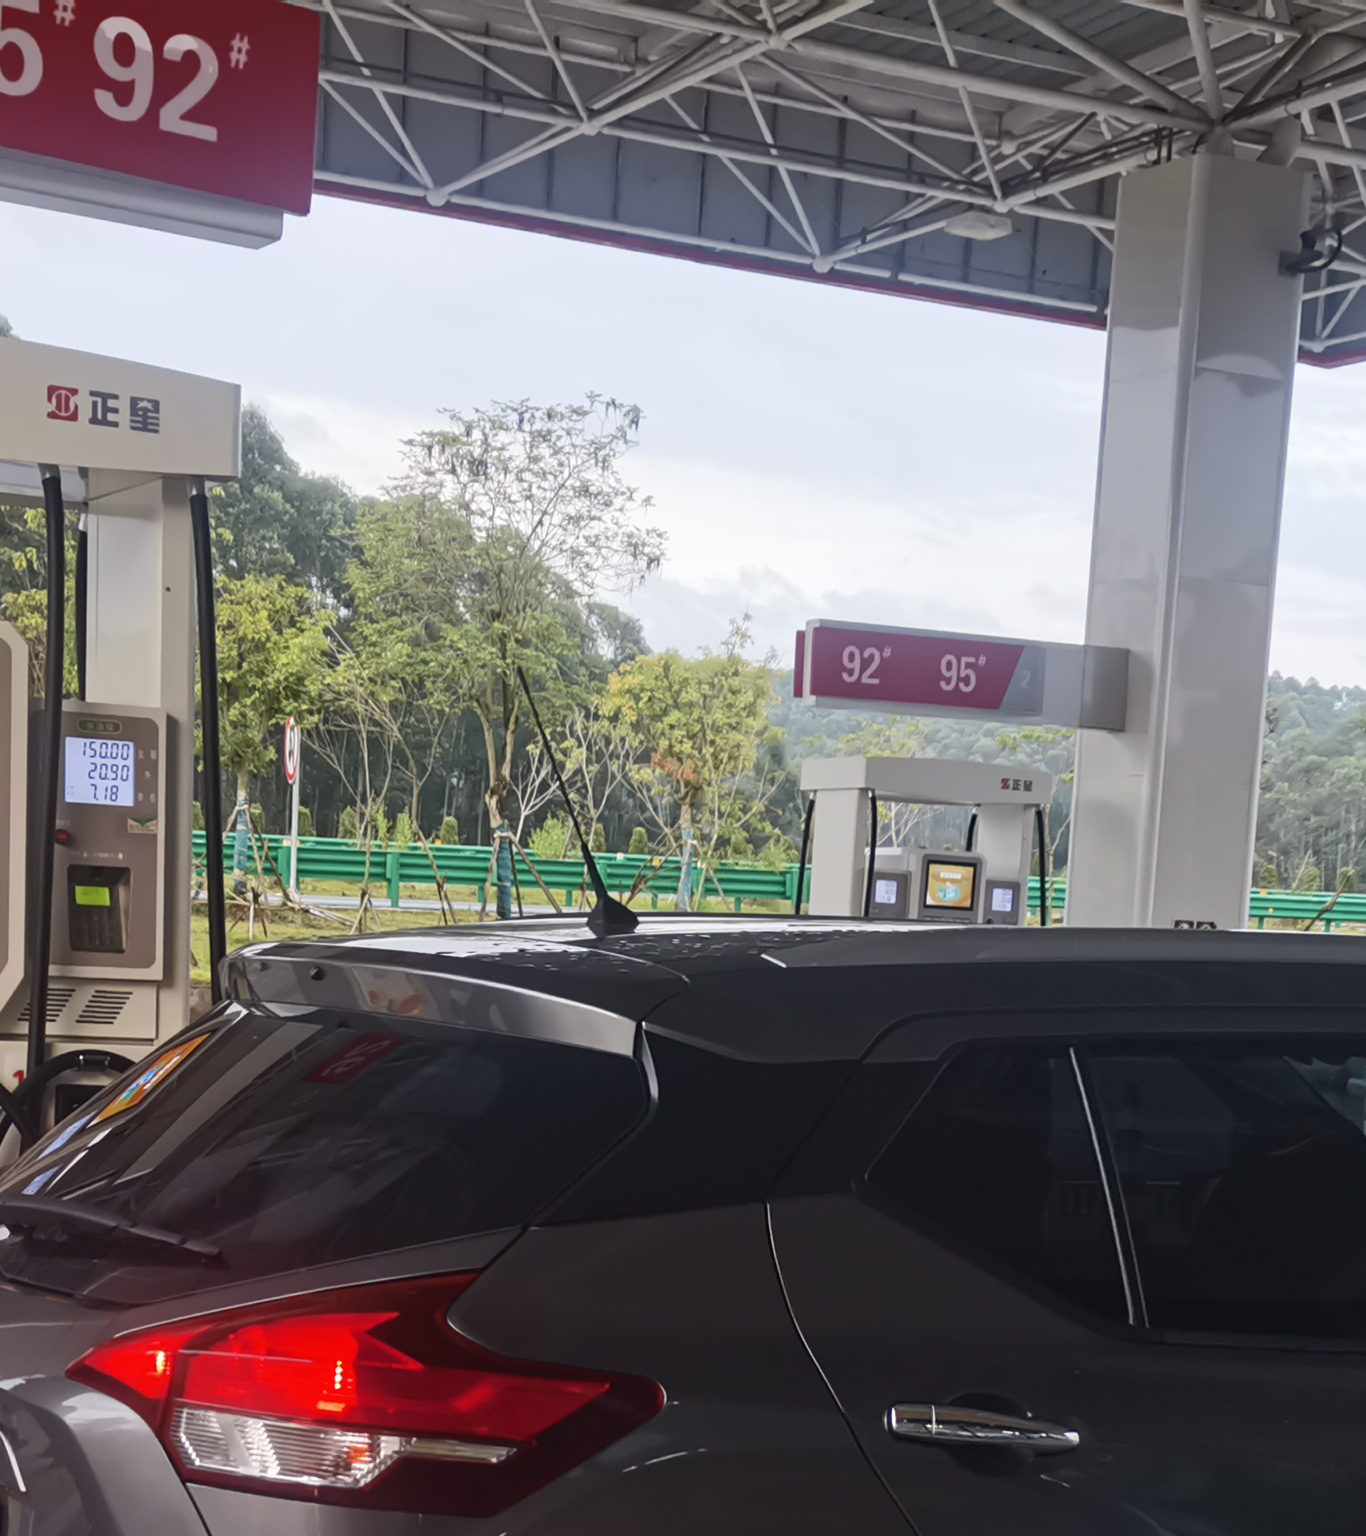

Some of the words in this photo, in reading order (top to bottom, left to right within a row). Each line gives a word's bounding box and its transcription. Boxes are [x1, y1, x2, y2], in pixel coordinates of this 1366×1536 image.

[83, 741, 130, 761] 150.00
[88, 762, 130, 782] 20.90
[90, 783, 119, 802] 7.18
